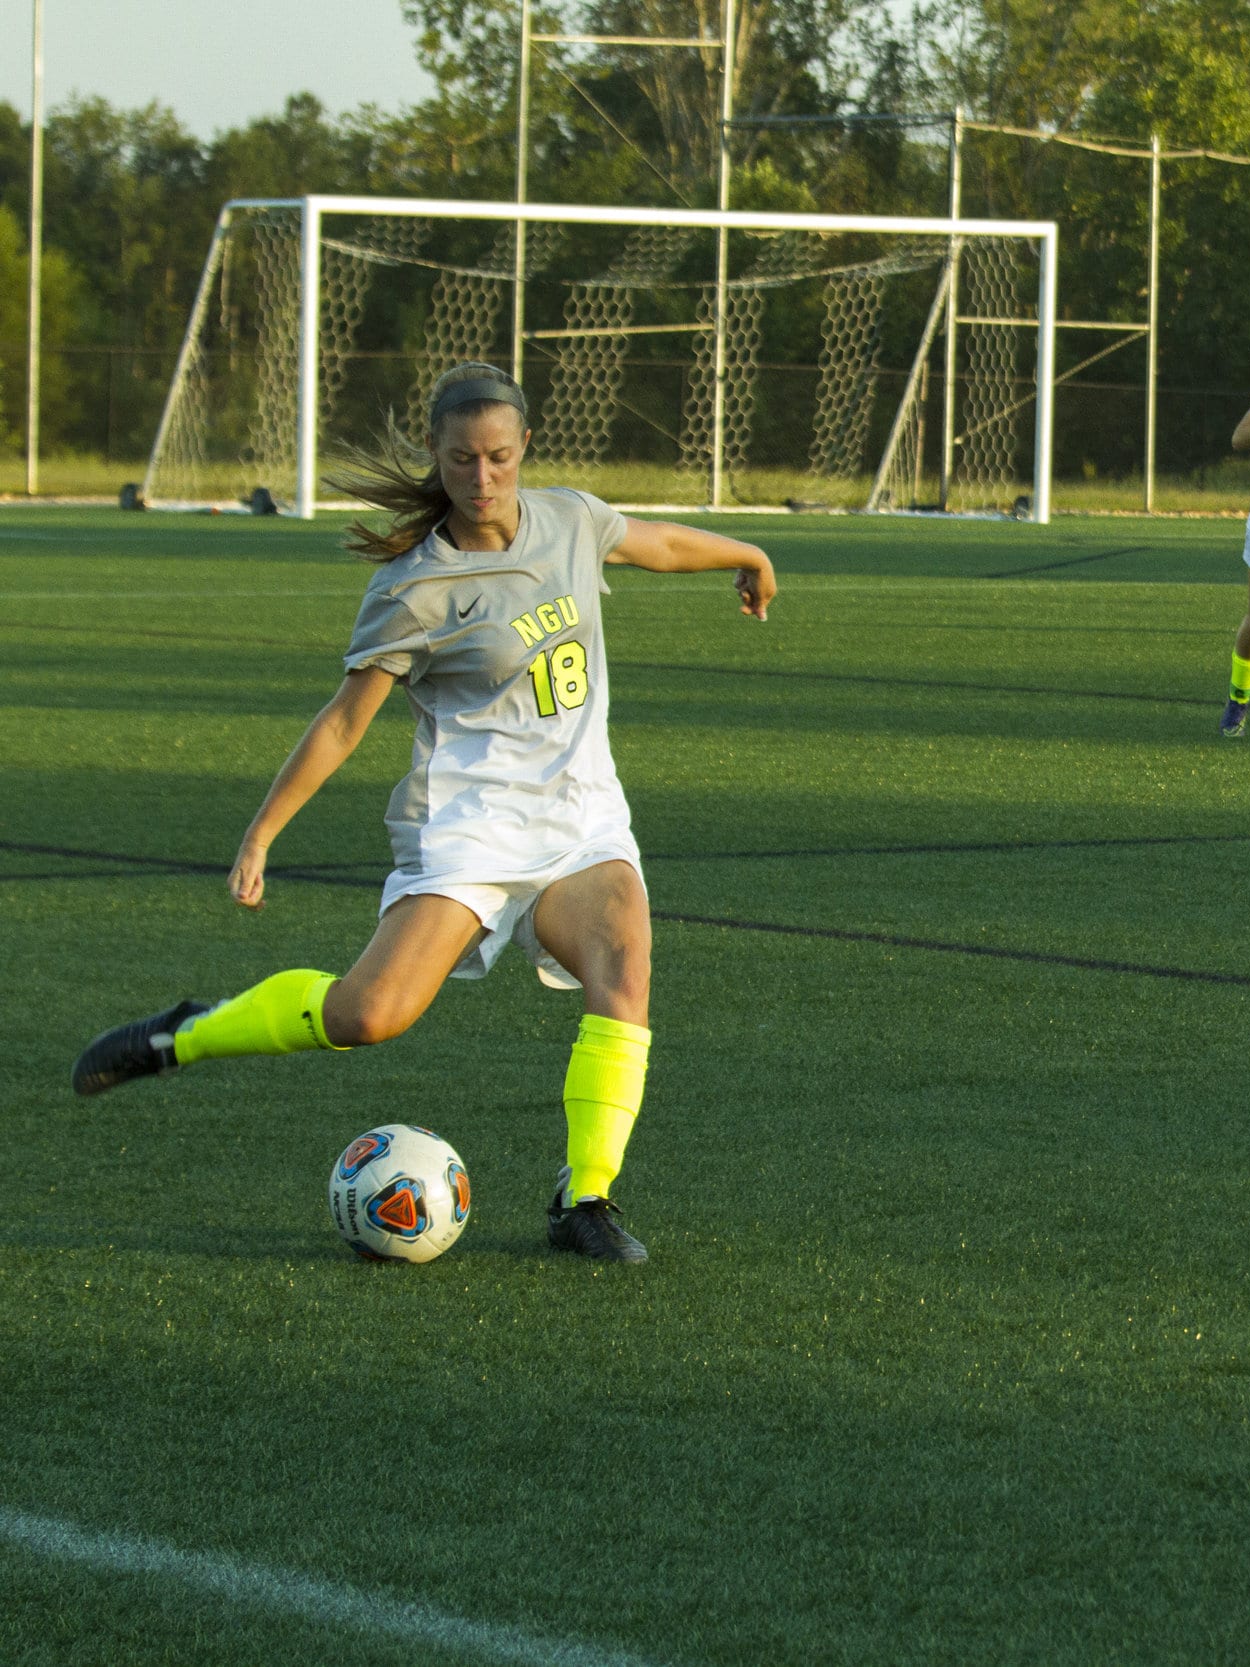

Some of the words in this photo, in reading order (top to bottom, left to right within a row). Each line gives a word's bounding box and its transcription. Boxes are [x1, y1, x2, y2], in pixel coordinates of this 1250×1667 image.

[510, 595, 579, 648] NGU
[527, 640, 588, 718] 18
[347, 1188, 360, 1236] Wilson
